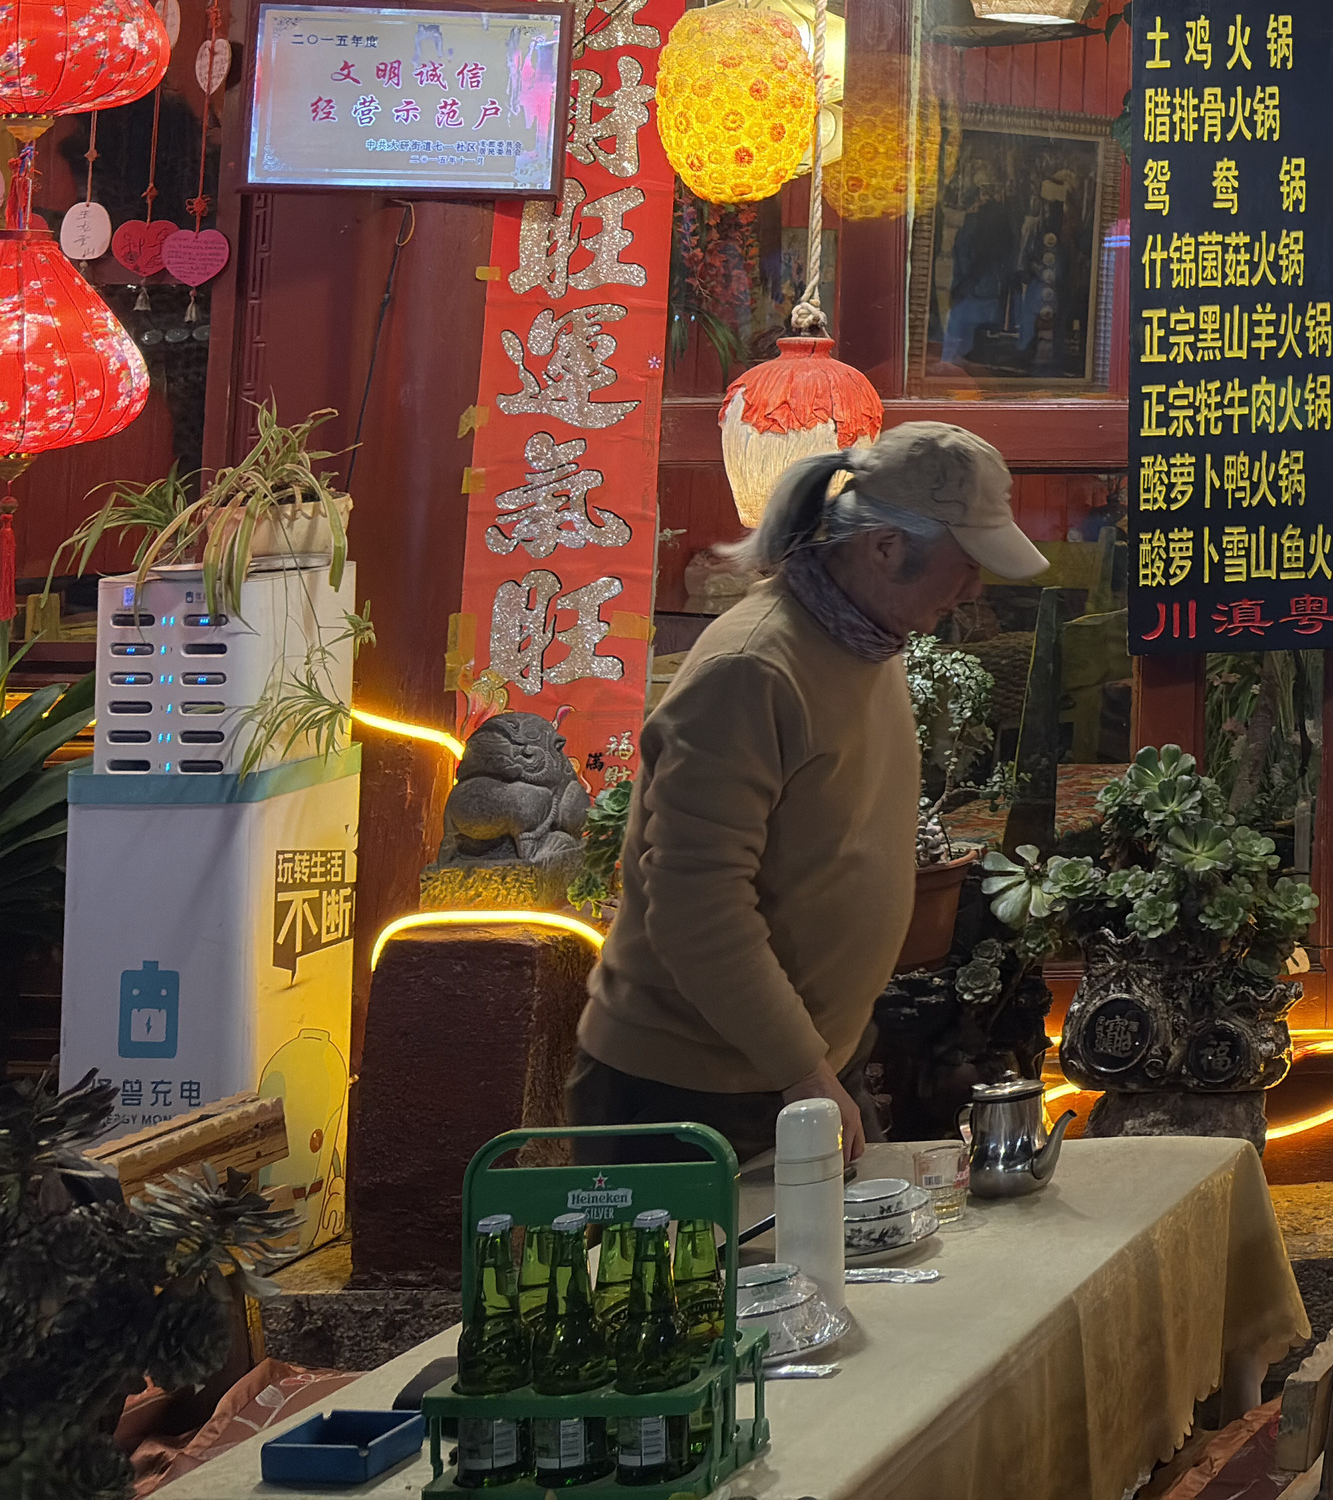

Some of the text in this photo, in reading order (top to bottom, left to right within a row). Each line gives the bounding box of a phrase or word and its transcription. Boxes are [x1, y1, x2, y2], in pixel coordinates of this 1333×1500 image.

[1145, 14, 1293, 70] 土鸡火锅
[330, 59, 488, 91] 文明诚信
[309, 96, 502, 130] 经营示范户
[1143, 86, 1280, 143] 腊排骨火锅
[1143, 156, 1306, 216] 鸳鸯锅
[1141, 229, 1305, 290] 什锦菌菇火锅
[1140, 301, 1333, 364] 正宗黑山羊火锅
[1139, 373, 1332, 438] 正宗牦牛肉火锅
[1138, 449, 1305, 513] 酸萝卜鸭火锅
[277, 852, 343, 883] 玩转生活
[276, 887, 356, 953] 不断
[91, 1079, 202, 1107] 兽充电
[571, 1192, 628, 1205] Heineken
[584, 1207, 615, 1220] SILVER
